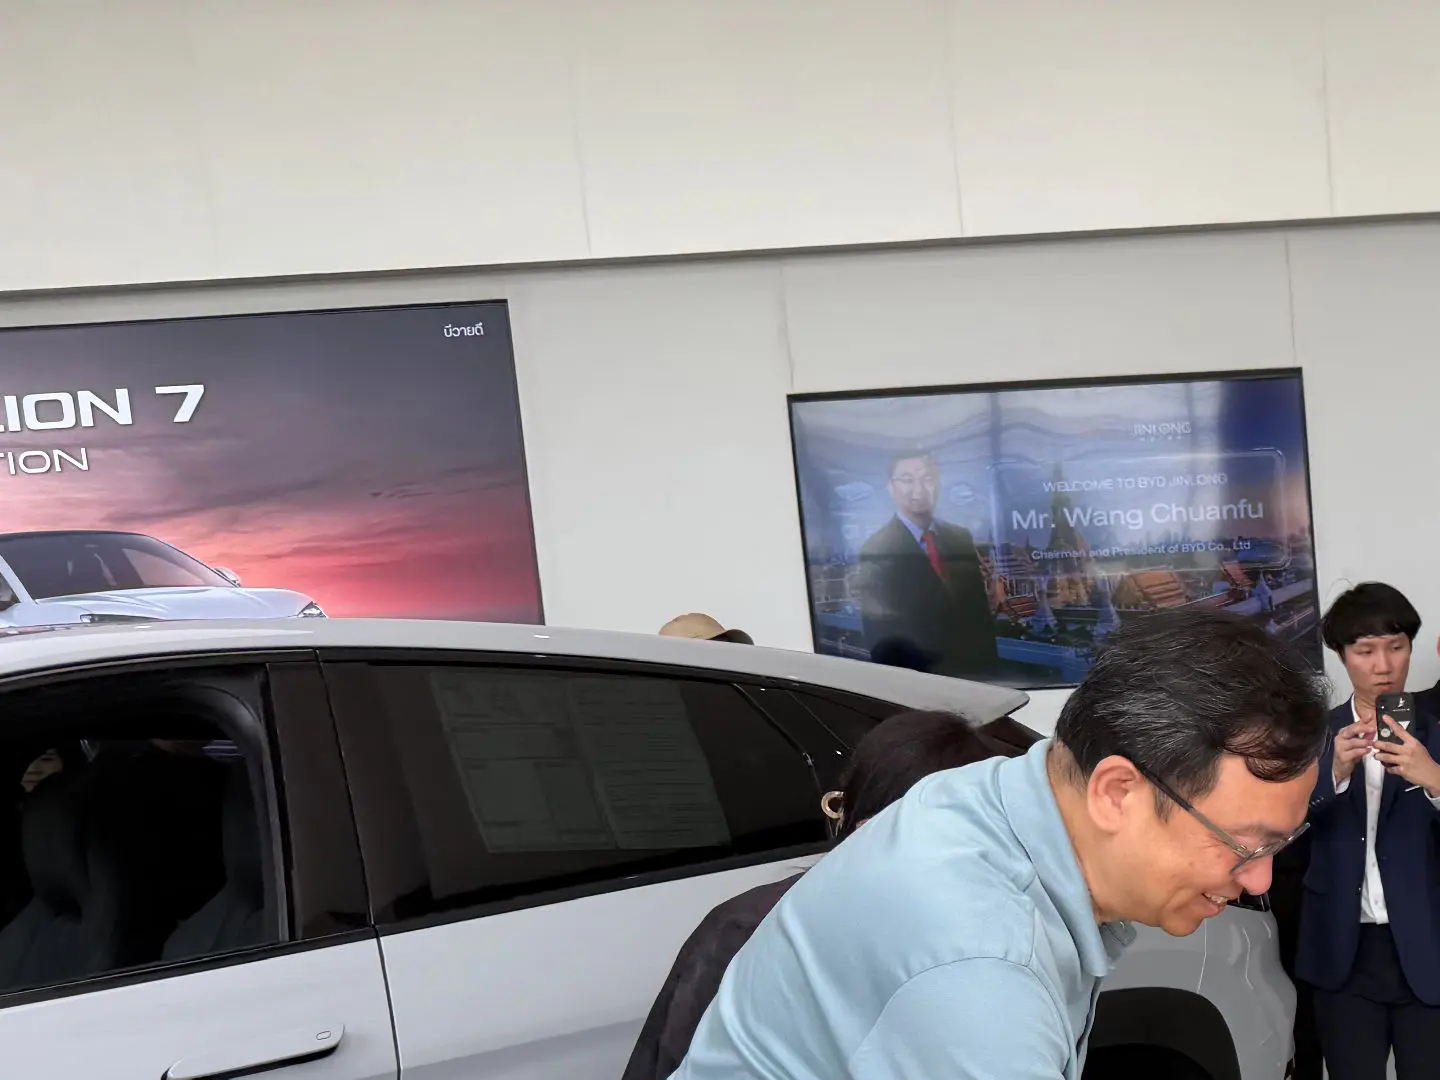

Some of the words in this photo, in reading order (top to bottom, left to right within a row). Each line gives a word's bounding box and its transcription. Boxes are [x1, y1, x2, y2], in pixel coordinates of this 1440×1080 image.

[0, 388, 133, 432] ION
[155, 384, 205, 423] 7
[1044, 479, 1114, 492] WELCOME
[1117, 477, 1136, 490] TO
[1138, 475, 1166, 489] BYD
[1012, 509, 1056, 530] Mr.
[1063, 506, 1144, 530] Wang
[1151, 498, 1264, 524] Chuanfu
[1032, 547, 1086, 560] Chairman
[1089, 547, 1110, 559] and
[1168, 542, 1180, 554] of
[1182, 541, 1206, 553] BYD
